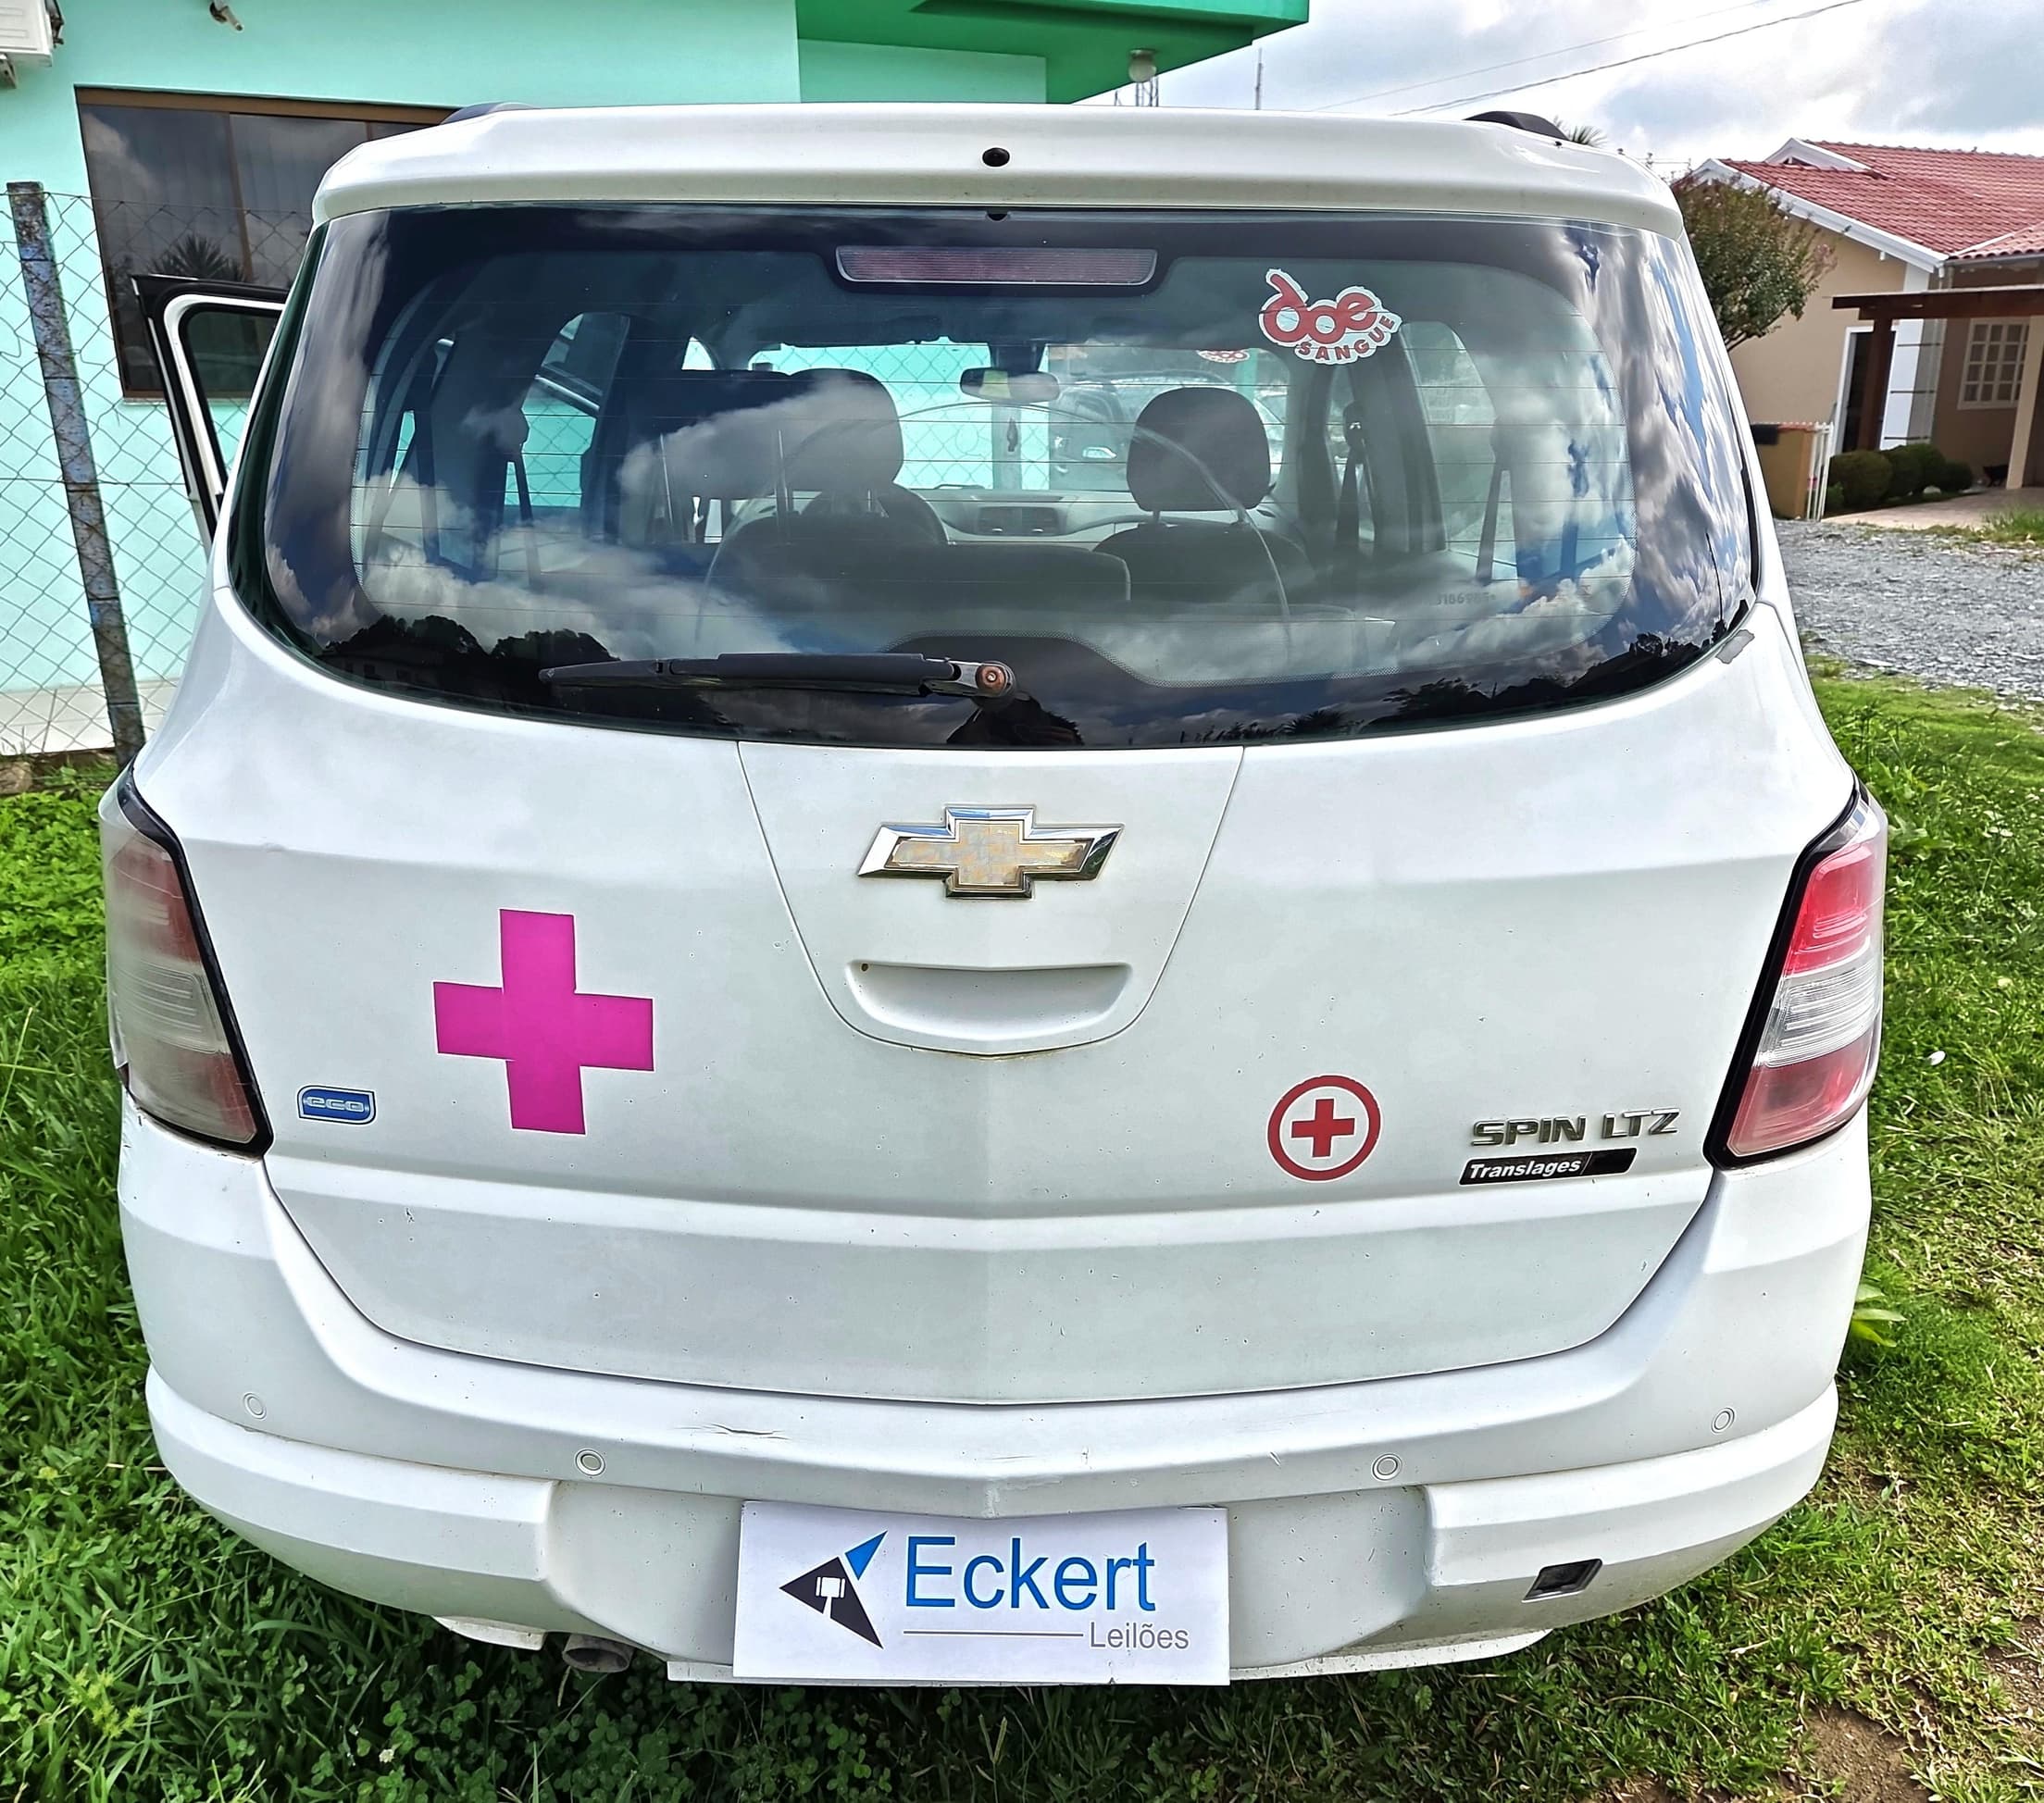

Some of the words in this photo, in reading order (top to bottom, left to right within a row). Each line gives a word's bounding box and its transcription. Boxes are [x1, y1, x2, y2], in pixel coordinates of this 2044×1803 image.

[1263, 274, 1378, 343] doe
[1299, 315, 1395, 361] SANGUE
[306, 1096, 365, 1113] eco
[1471, 1115, 1586, 1147] SPIN
[1601, 1107, 1680, 1139] LTZ
[1469, 1160, 1581, 1179] Translages
[905, 1536, 1157, 1611] Eckert
[1090, 1621, 1190, 1650] Leilões
